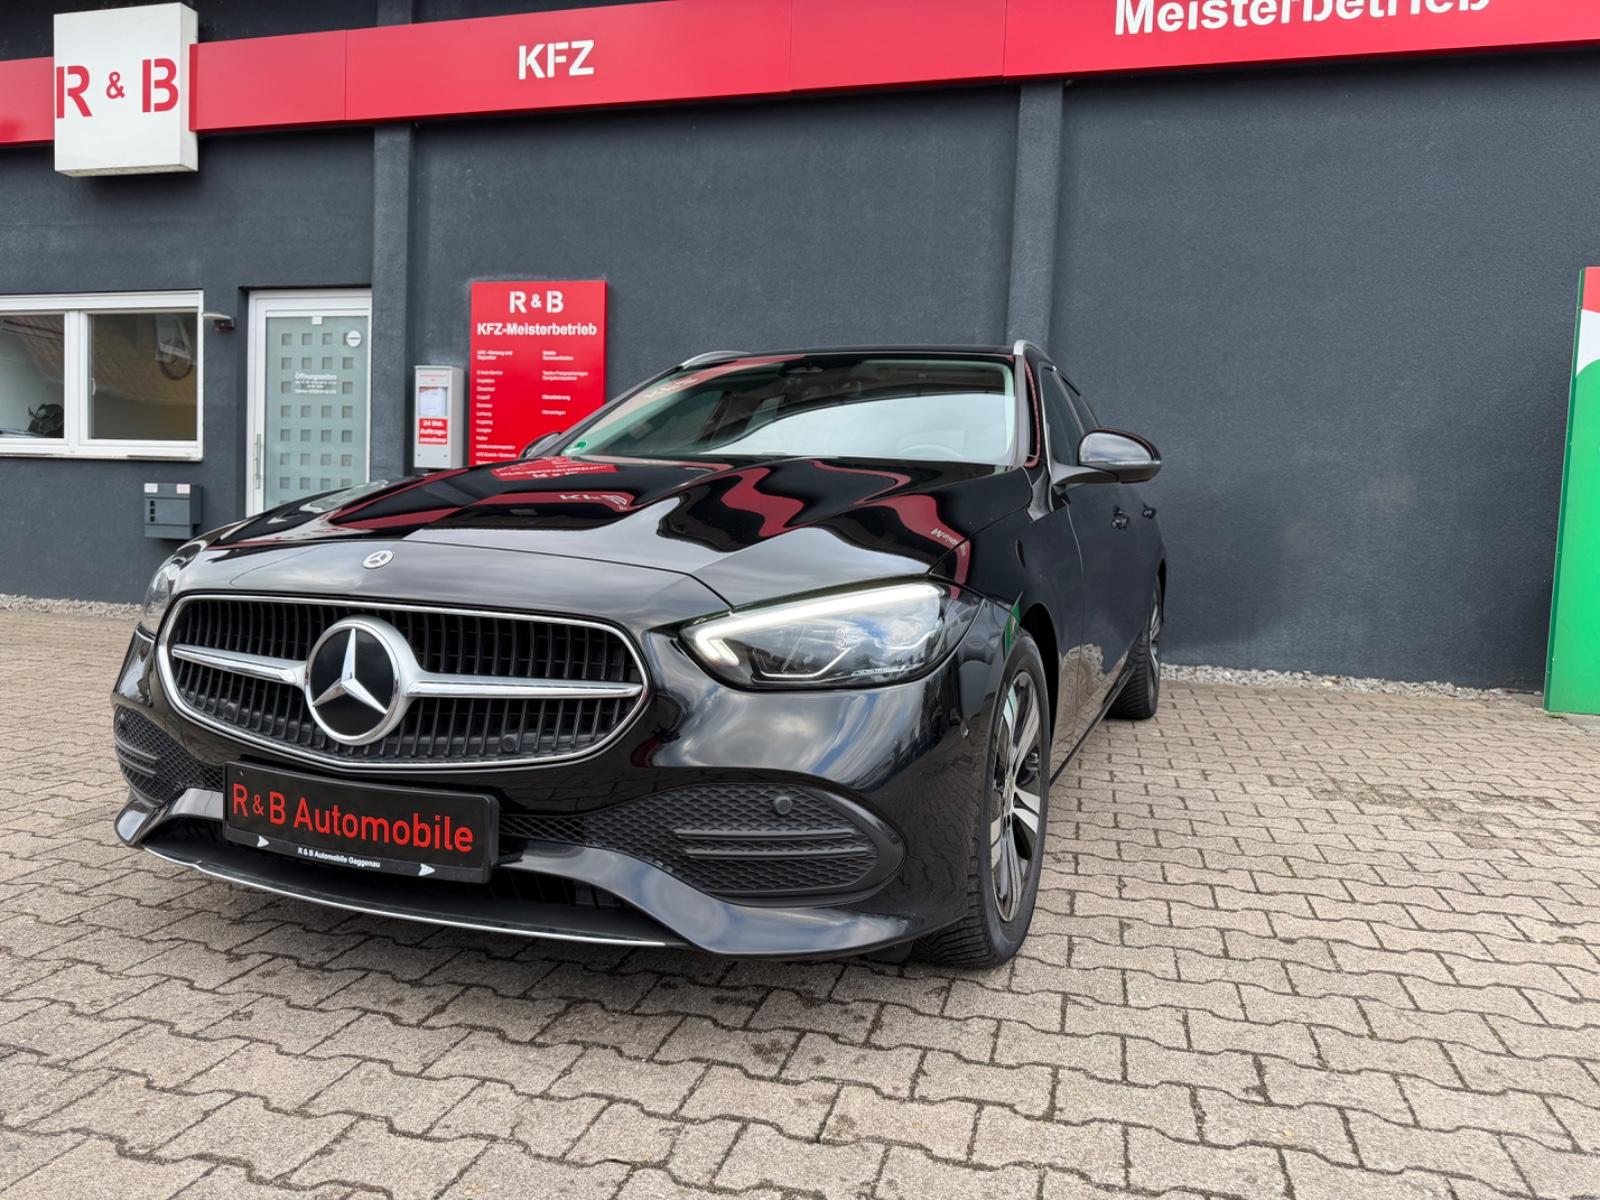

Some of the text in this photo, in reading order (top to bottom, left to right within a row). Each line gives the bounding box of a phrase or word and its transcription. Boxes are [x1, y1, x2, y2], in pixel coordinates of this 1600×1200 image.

[1115, 0, 1490, 36] Meisterber
[518, 39, 595, 80] KFZ
[56, 58, 179, 119] R & B
[509, 290, 564, 314] R & B
[476, 322, 598, 336] KFZ-Meisterbetrieb
[233, 783, 474, 852] R & B Automobile
[297, 847, 381, 868] R & B Automobile Gaggenau
